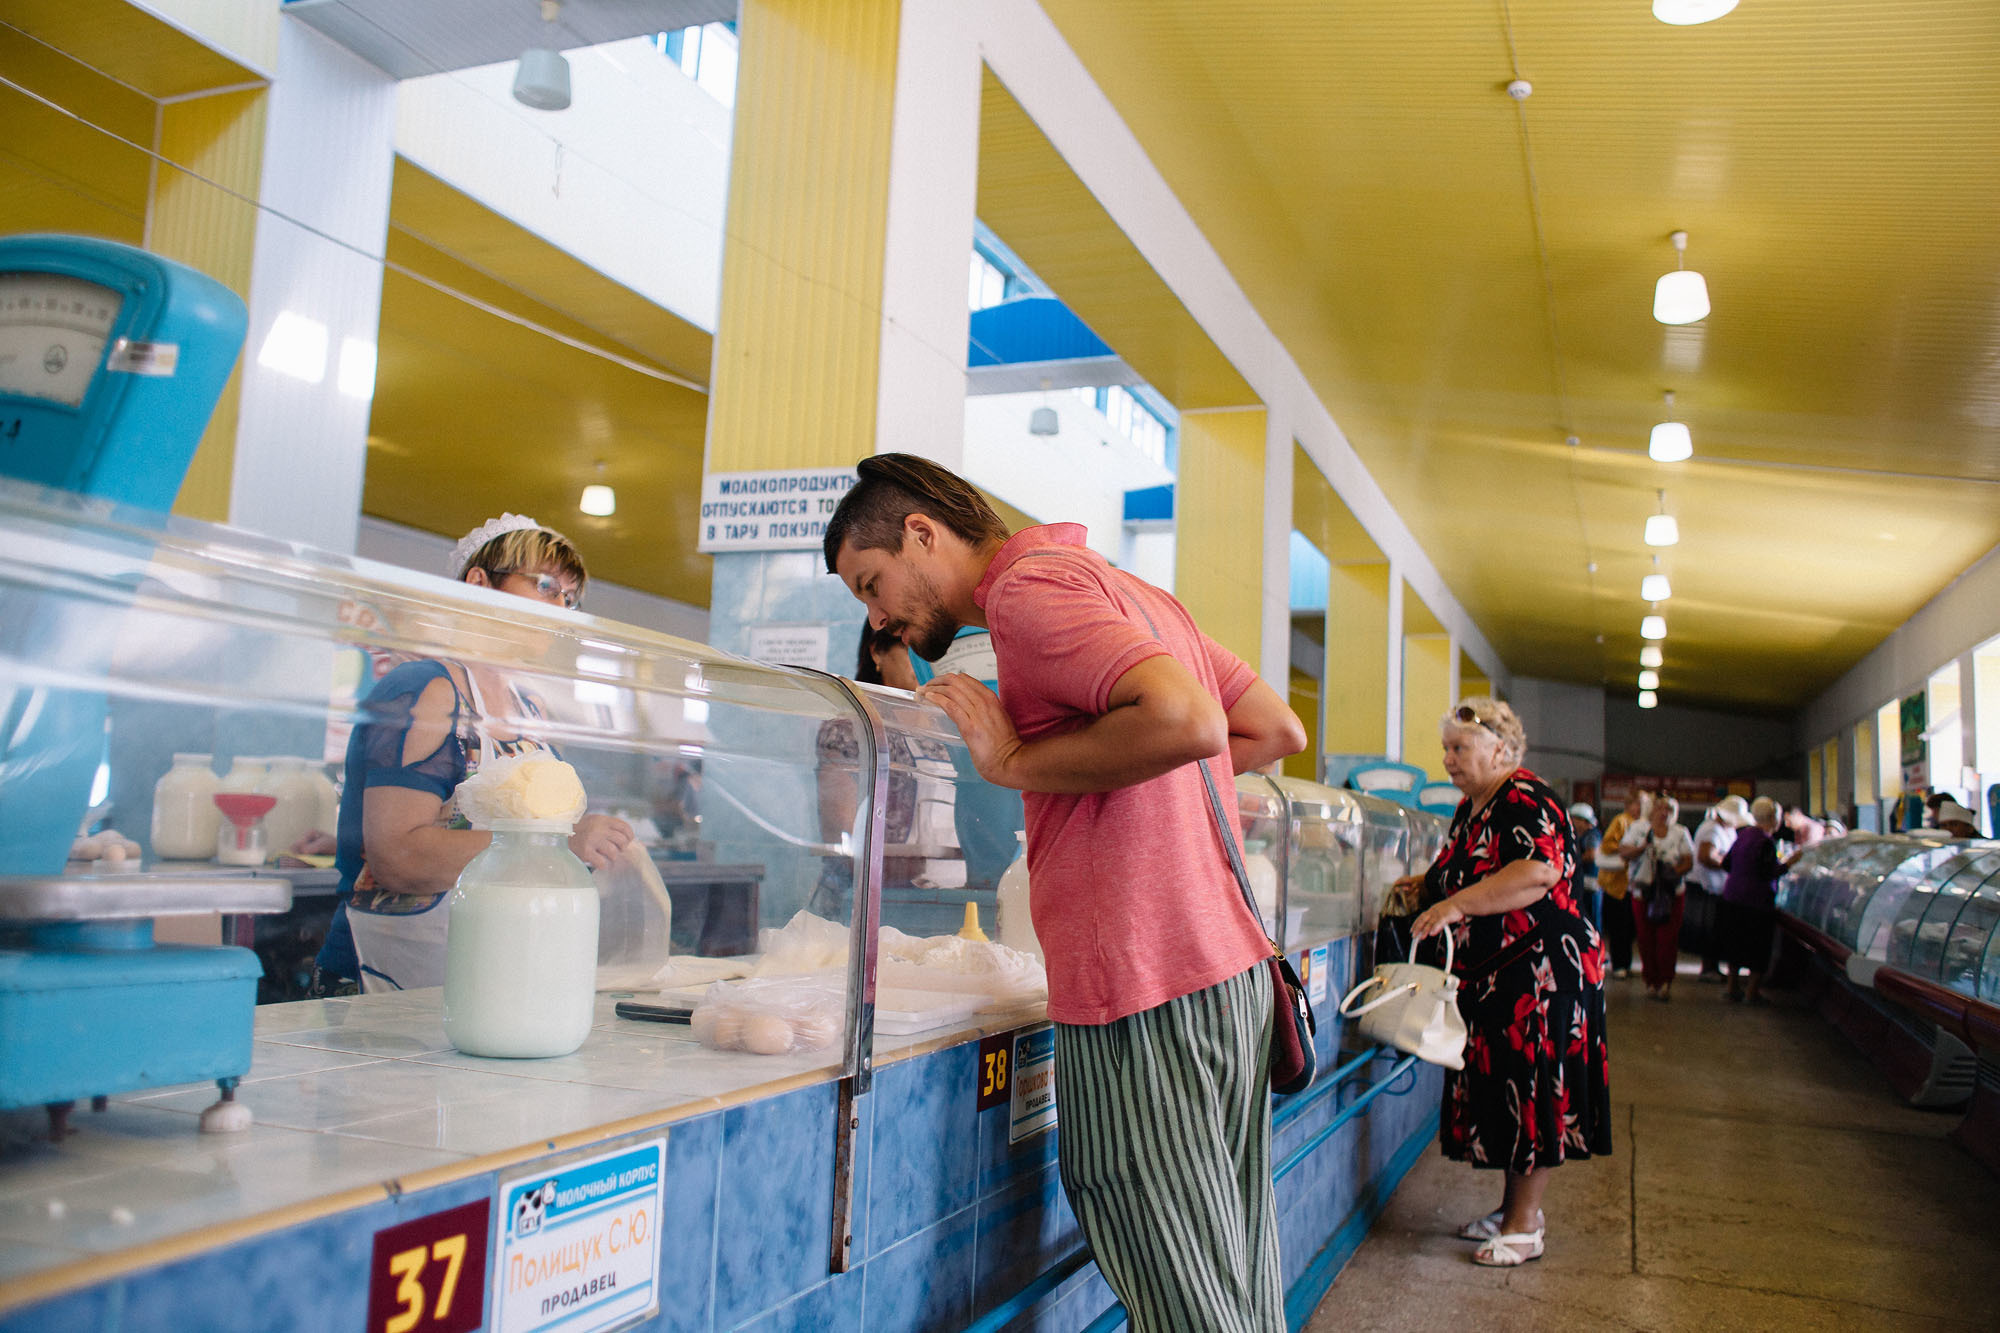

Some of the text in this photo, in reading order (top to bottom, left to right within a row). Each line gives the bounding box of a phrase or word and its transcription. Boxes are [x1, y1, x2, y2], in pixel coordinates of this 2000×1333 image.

[702, 499, 807, 518] ОТПУСКАЮТСЯ
[707, 525, 715, 540] В
[724, 523, 759, 540] ТАРУ
[983, 1049, 1007, 1097] 38
[555, 1162, 657, 1208] МОЛОЧНЫЙ КОРПУС
[509, 1208, 651, 1294] Полищук С.Ю.
[385, 1233, 468, 1333] 37
[541, 1270, 617, 1316] ПРОДАВЕЦ
